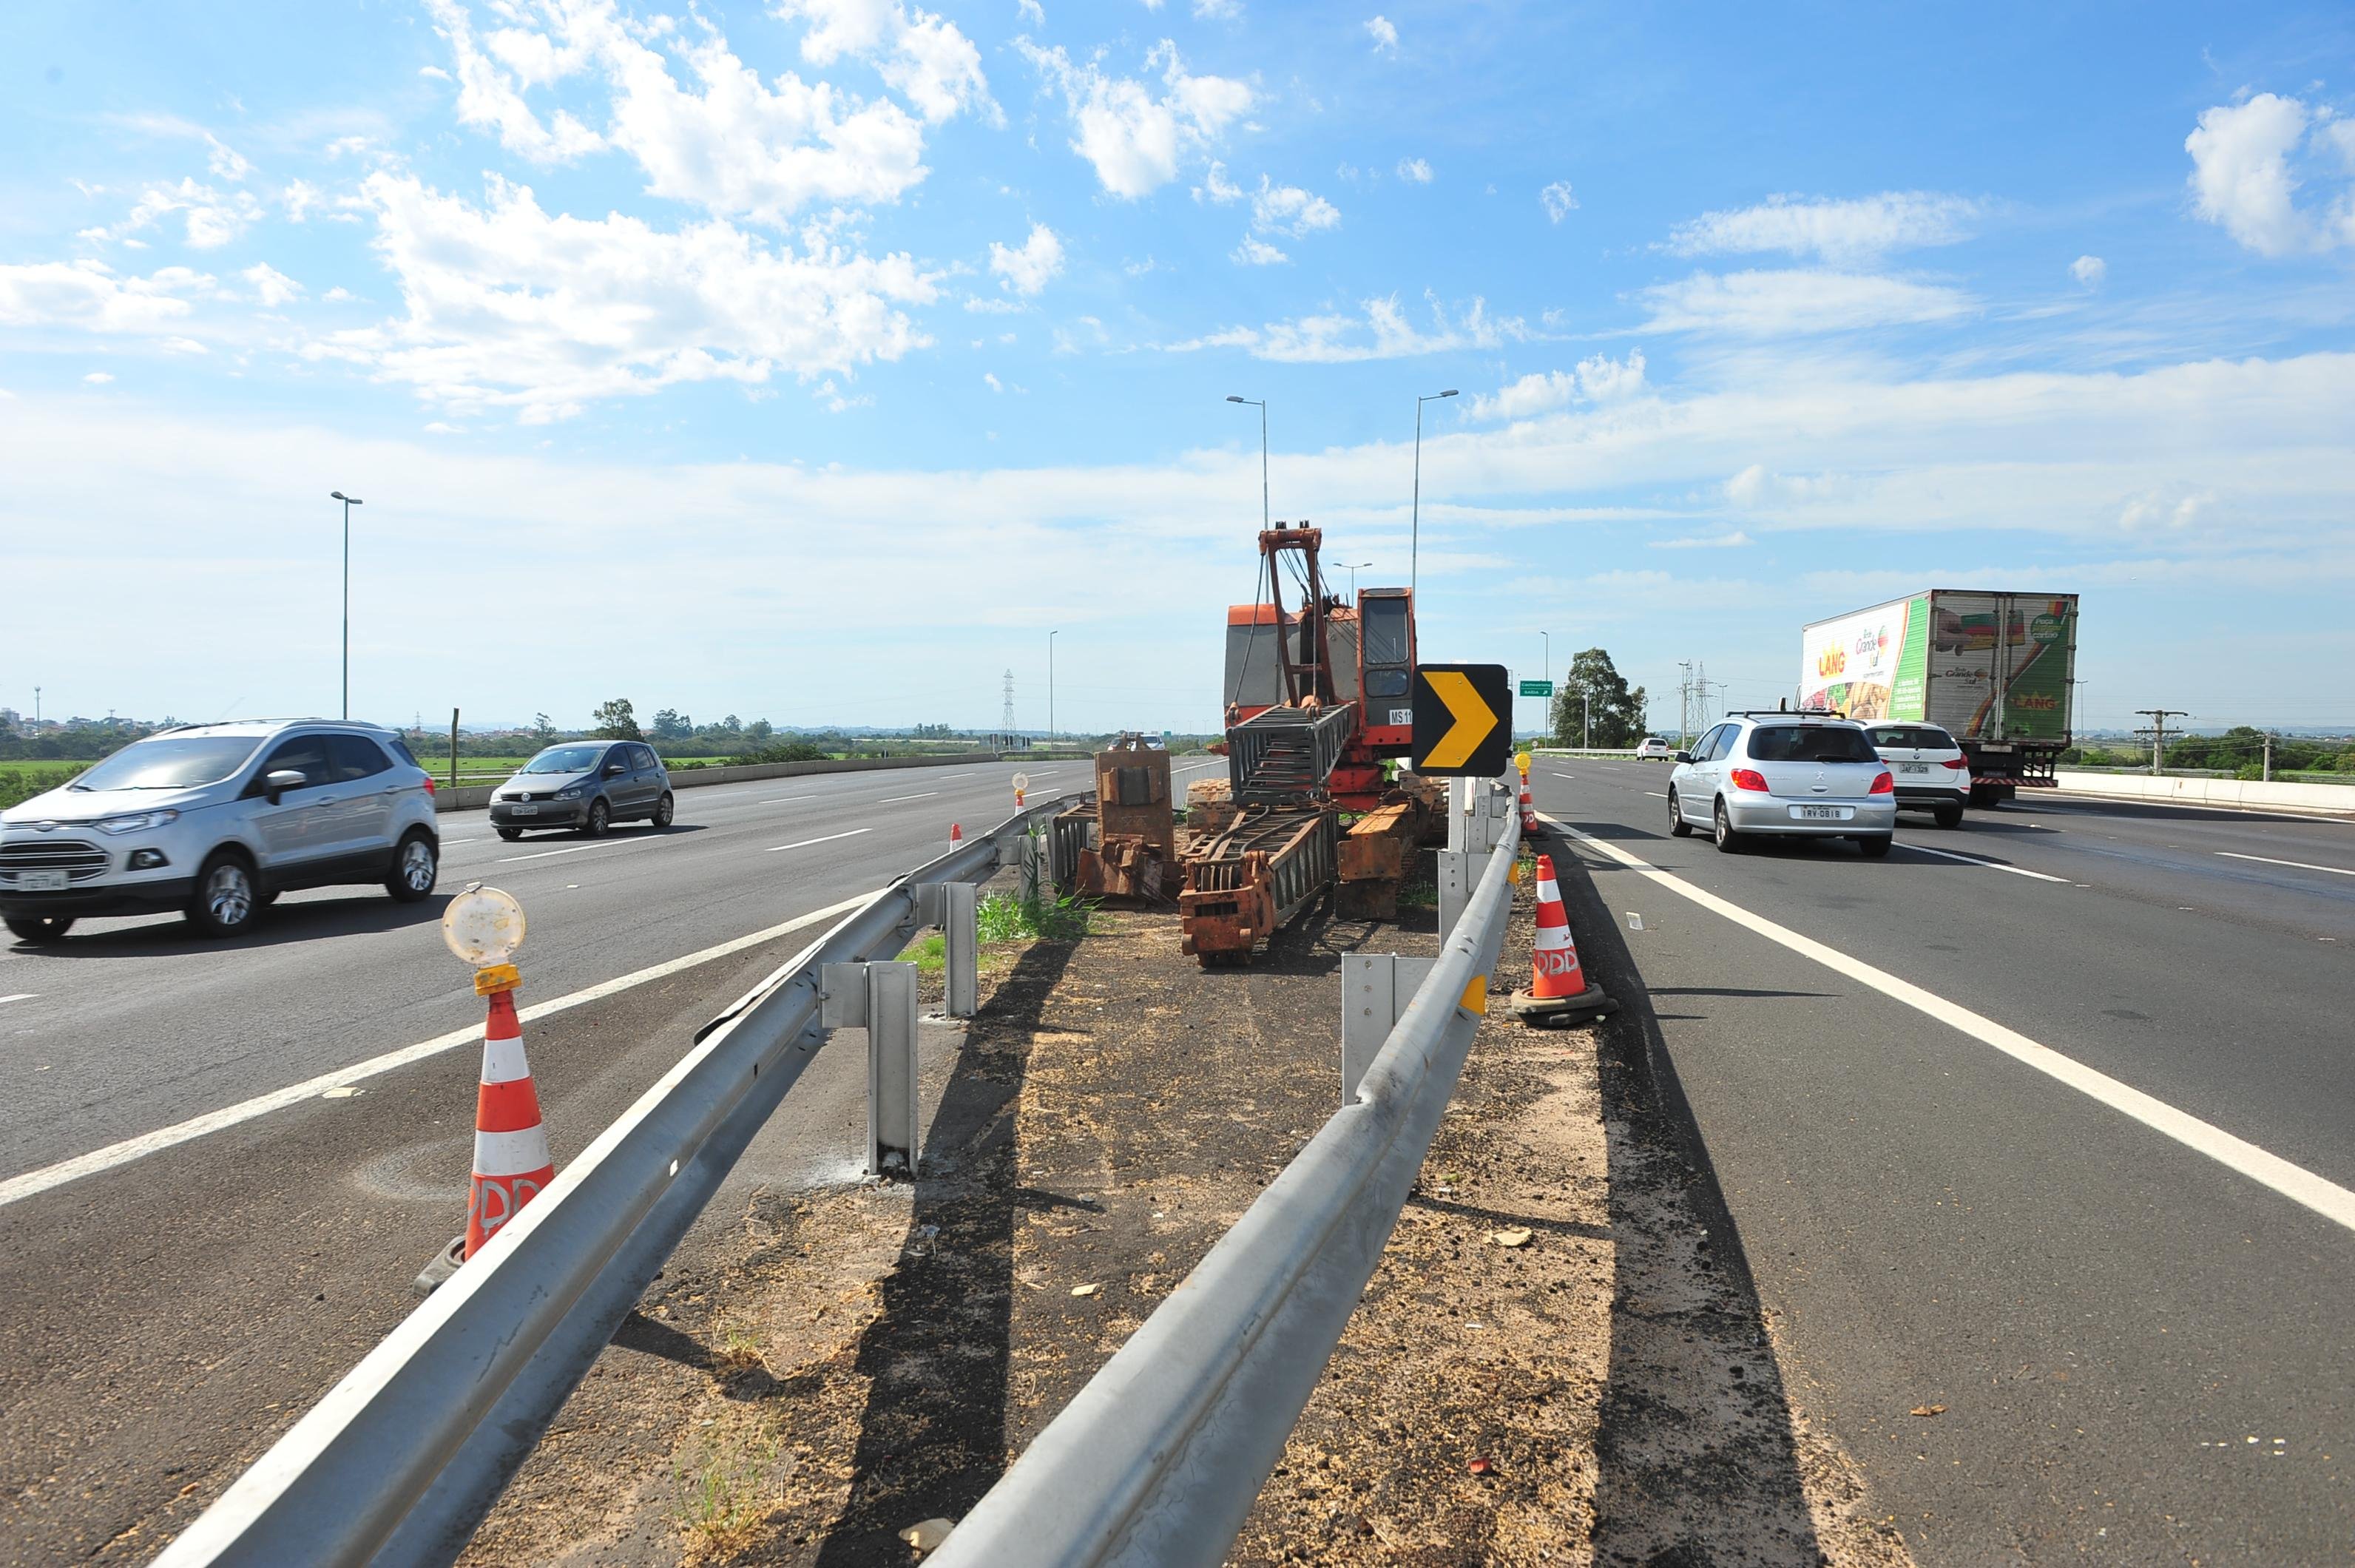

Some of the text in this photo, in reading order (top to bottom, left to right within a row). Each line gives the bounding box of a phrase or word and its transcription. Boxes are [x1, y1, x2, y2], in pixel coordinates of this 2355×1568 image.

[1856, 635, 1877, 655] Grande
[1819, 651, 1845, 677] LANG
[1946, 669, 1974, 678] Grande
[2013, 697, 2056, 709] LANG
[1391, 711, 1403, 723] MS
